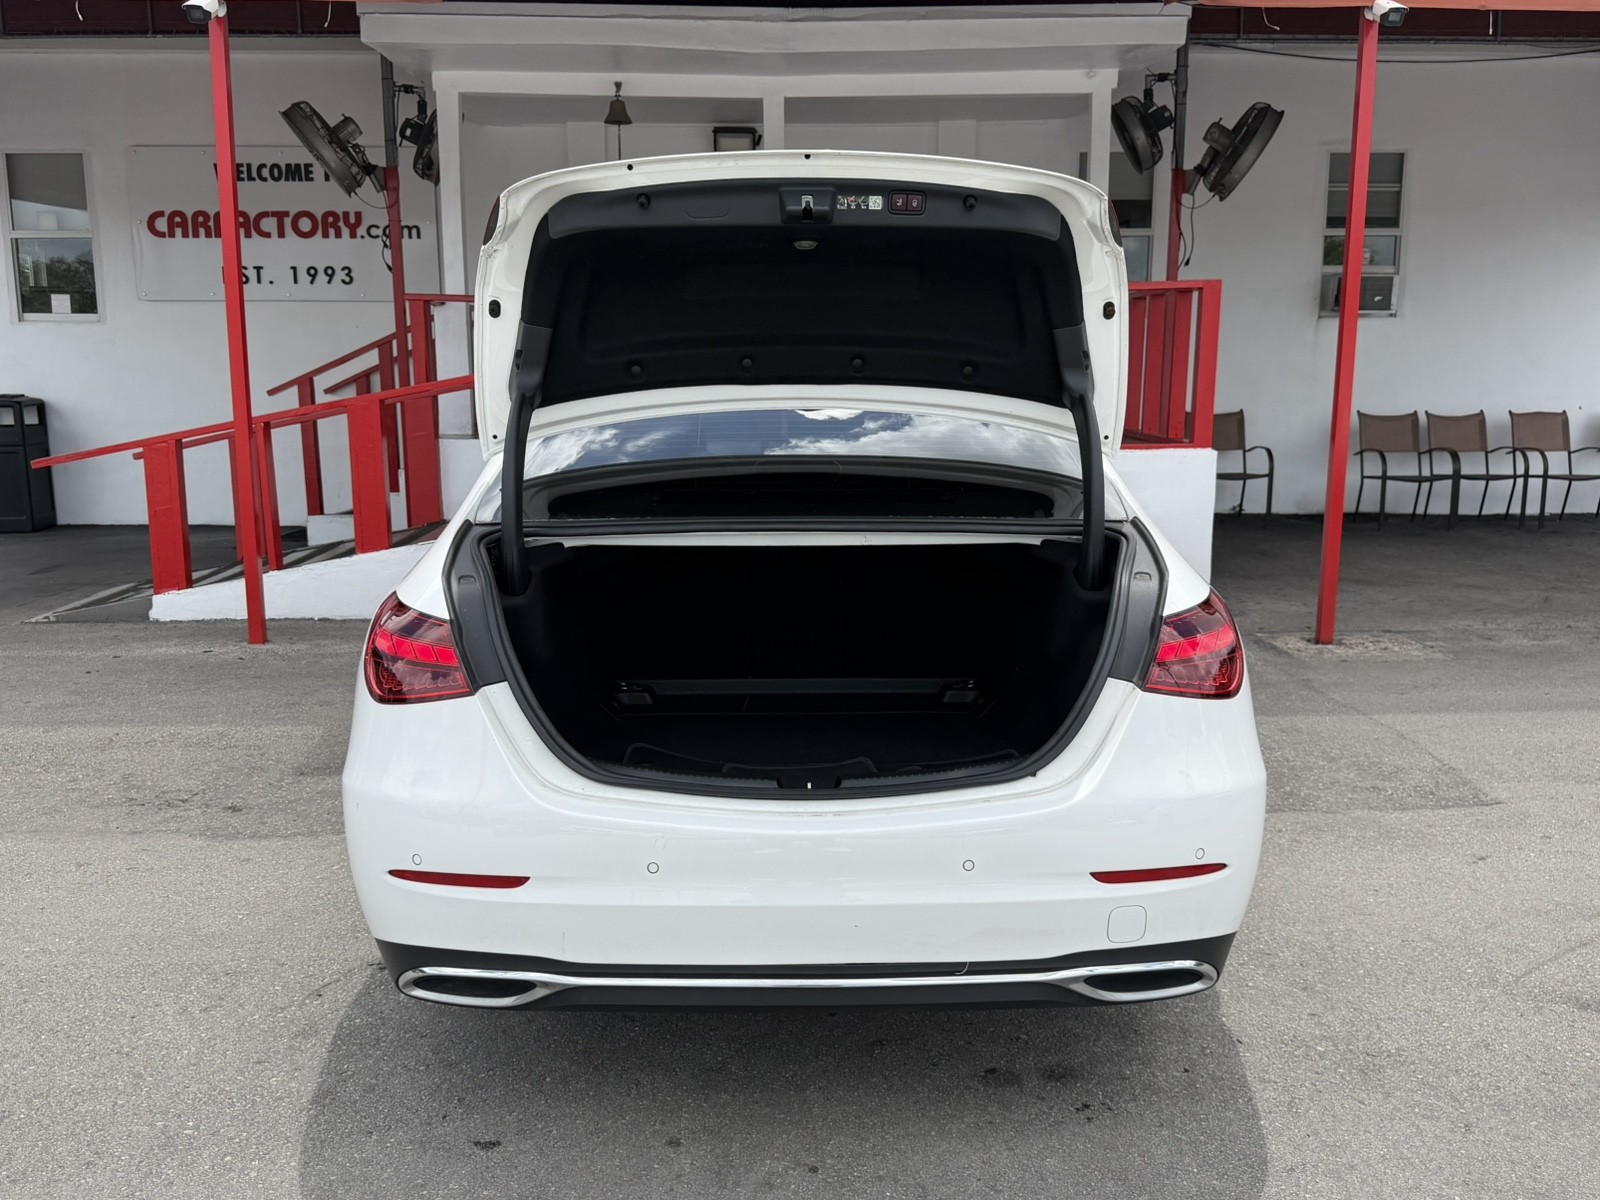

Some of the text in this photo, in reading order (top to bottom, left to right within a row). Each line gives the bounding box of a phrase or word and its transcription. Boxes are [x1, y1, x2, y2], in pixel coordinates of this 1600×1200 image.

[213, 163, 314, 182] ELCOME
[222, 265, 354, 285] ST. 1993
